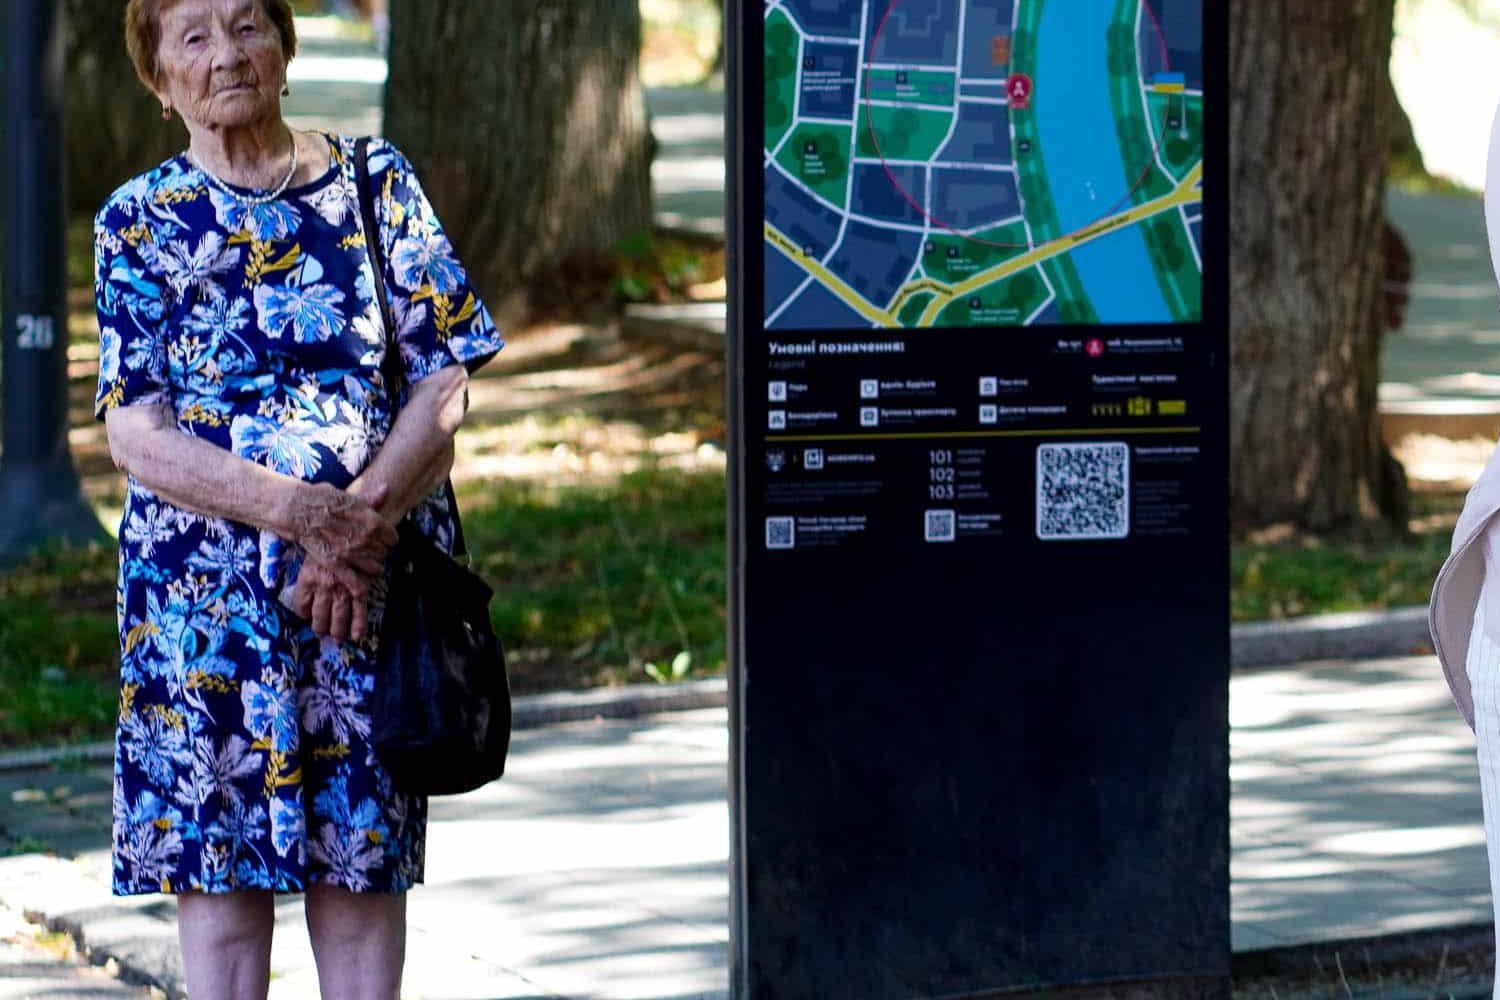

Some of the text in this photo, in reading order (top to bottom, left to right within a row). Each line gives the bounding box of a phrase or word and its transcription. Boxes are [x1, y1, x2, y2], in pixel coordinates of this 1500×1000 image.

[927, 450, 951, 465] 101
[927, 468, 953, 484] 102
[927, 486, 953, 501] 103
